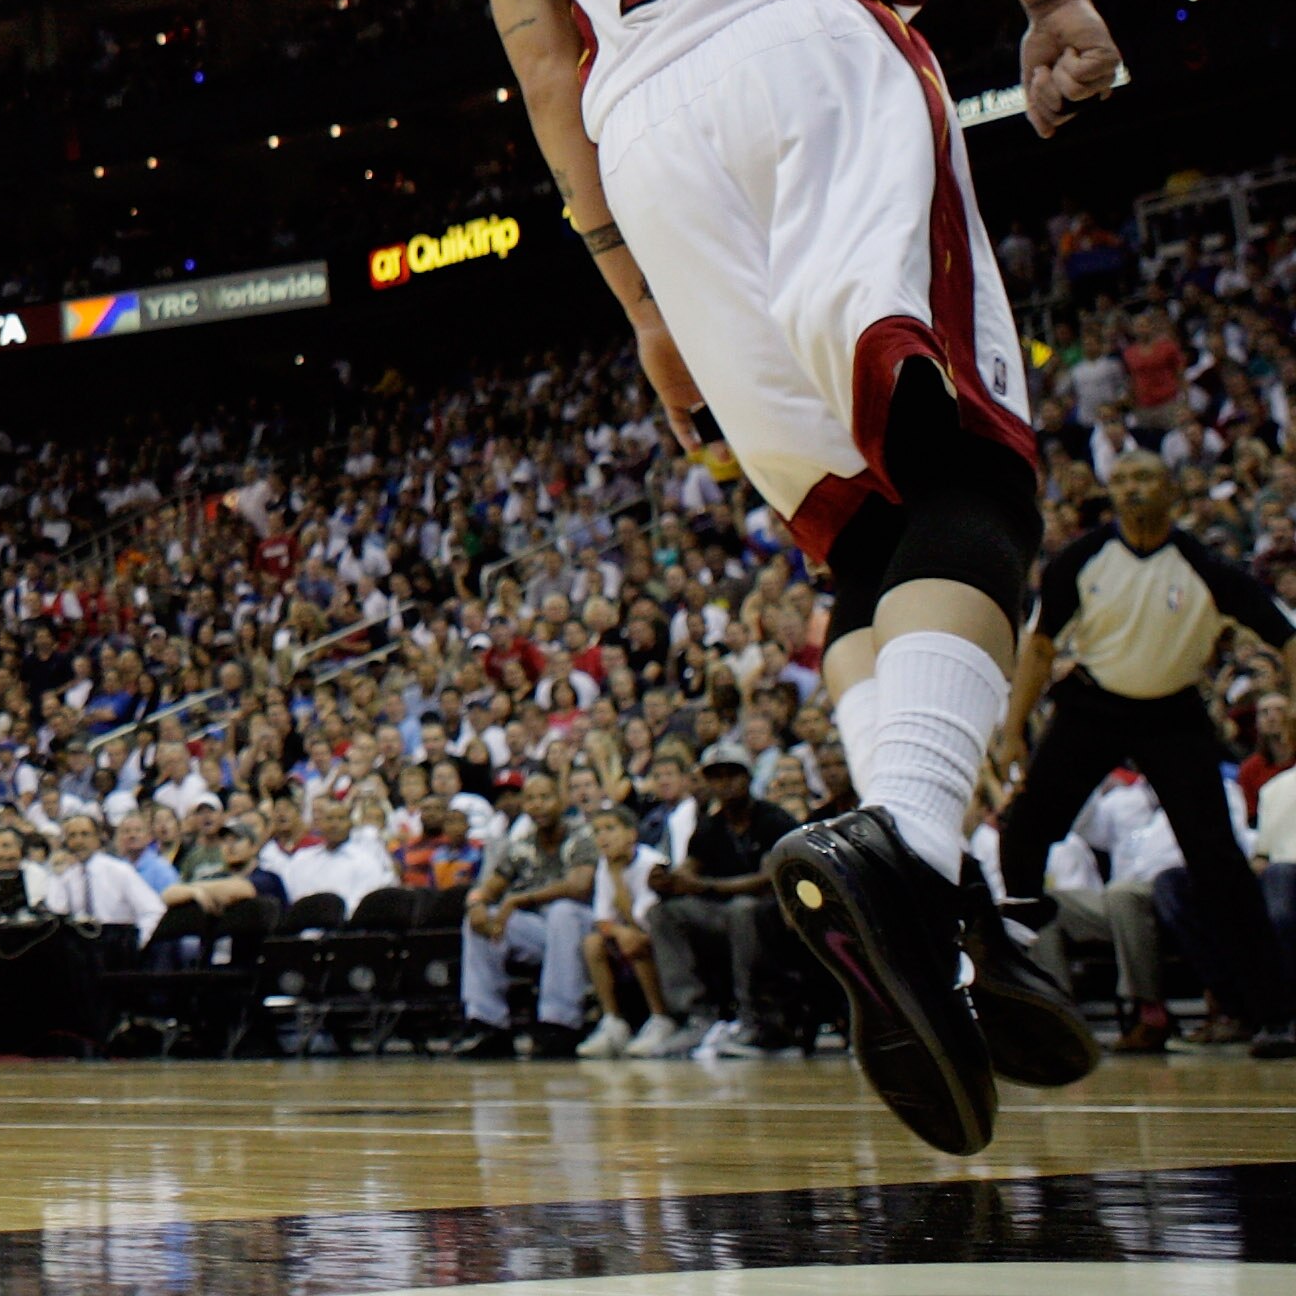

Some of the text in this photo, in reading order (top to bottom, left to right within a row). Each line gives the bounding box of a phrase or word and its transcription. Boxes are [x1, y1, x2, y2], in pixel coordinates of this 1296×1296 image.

[408, 213, 520, 273] QuikTrip
[146, 272, 327, 322] YRC orldwide
